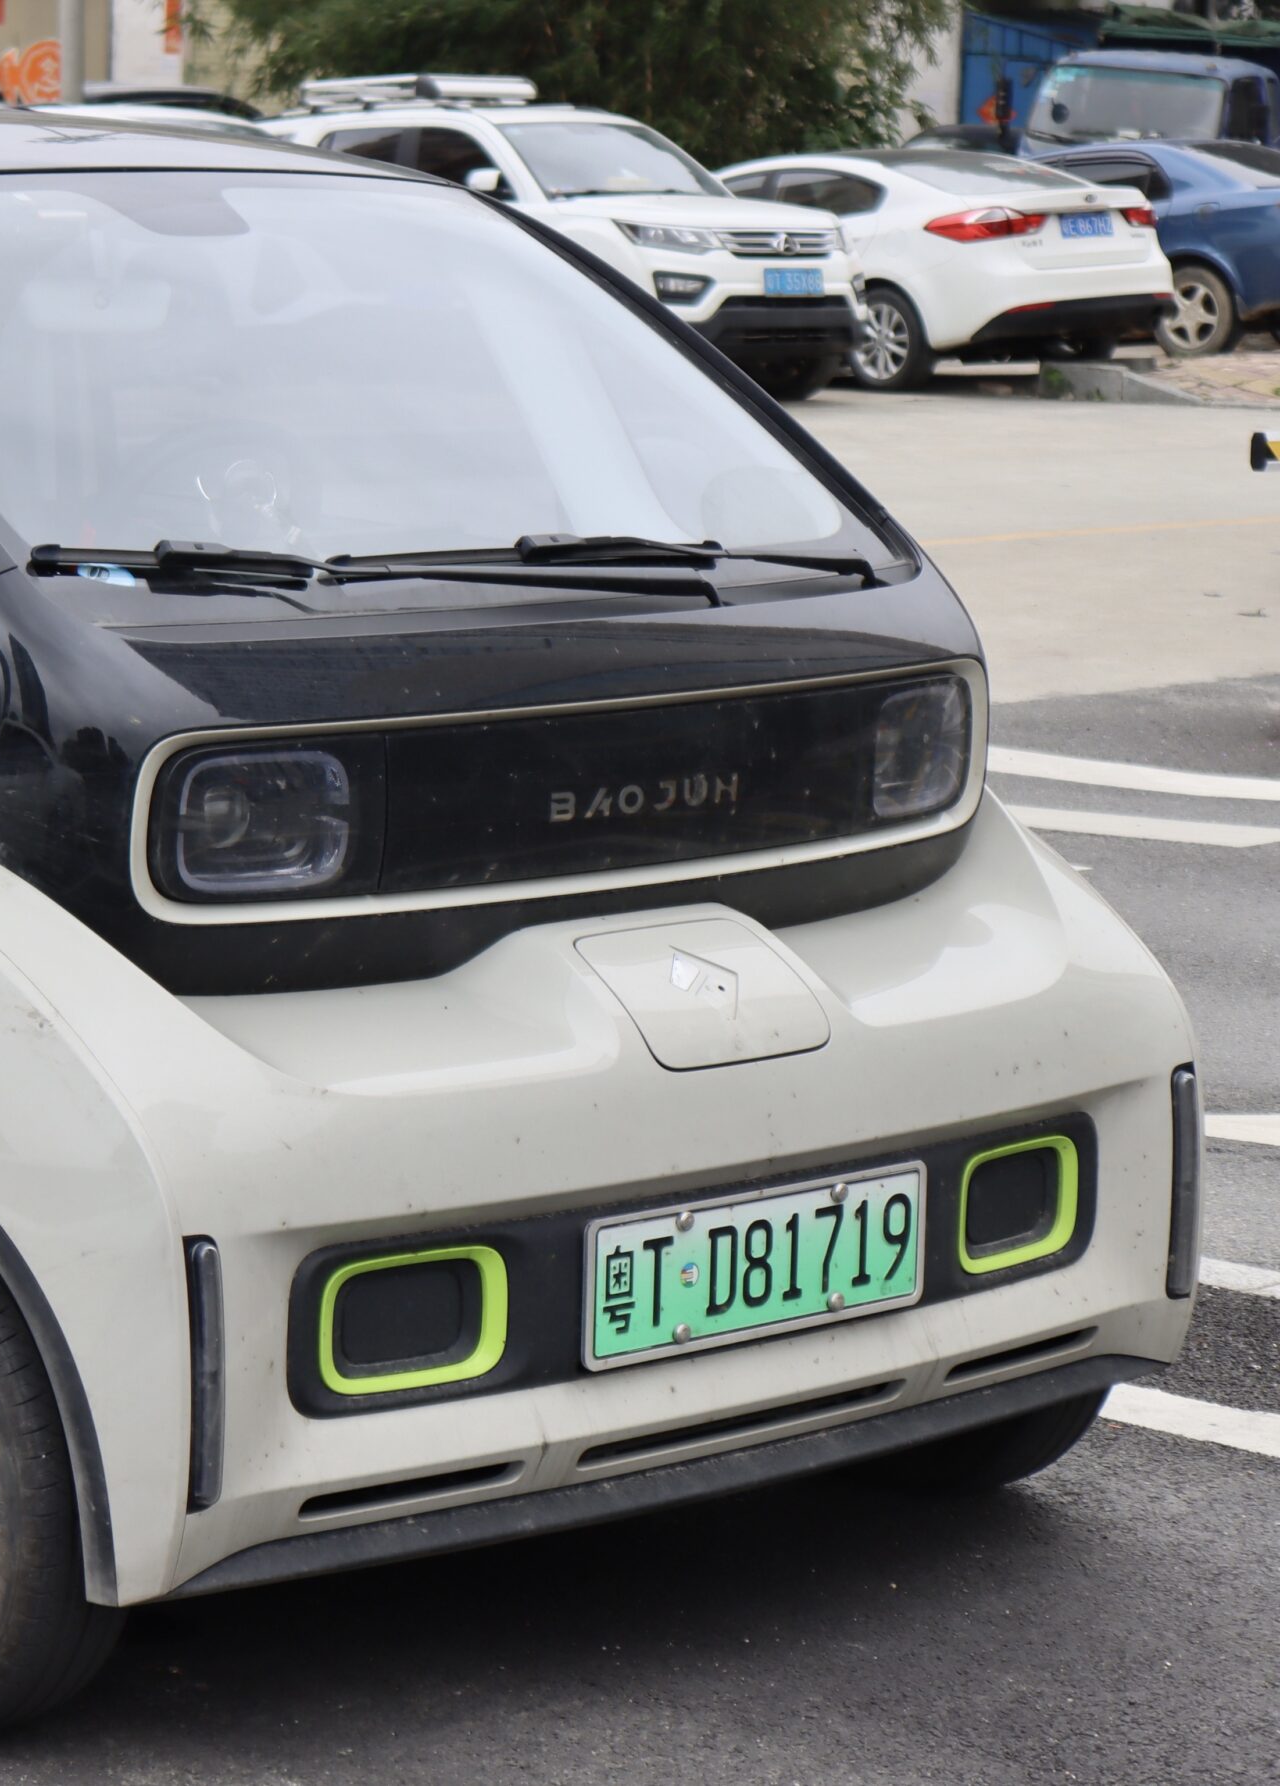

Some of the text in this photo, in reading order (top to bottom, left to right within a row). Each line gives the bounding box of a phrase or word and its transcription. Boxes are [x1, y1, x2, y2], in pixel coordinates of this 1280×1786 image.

[549, 772, 739, 823] BAOJUN
[602, 1192, 913, 1335] 粤T D81719
